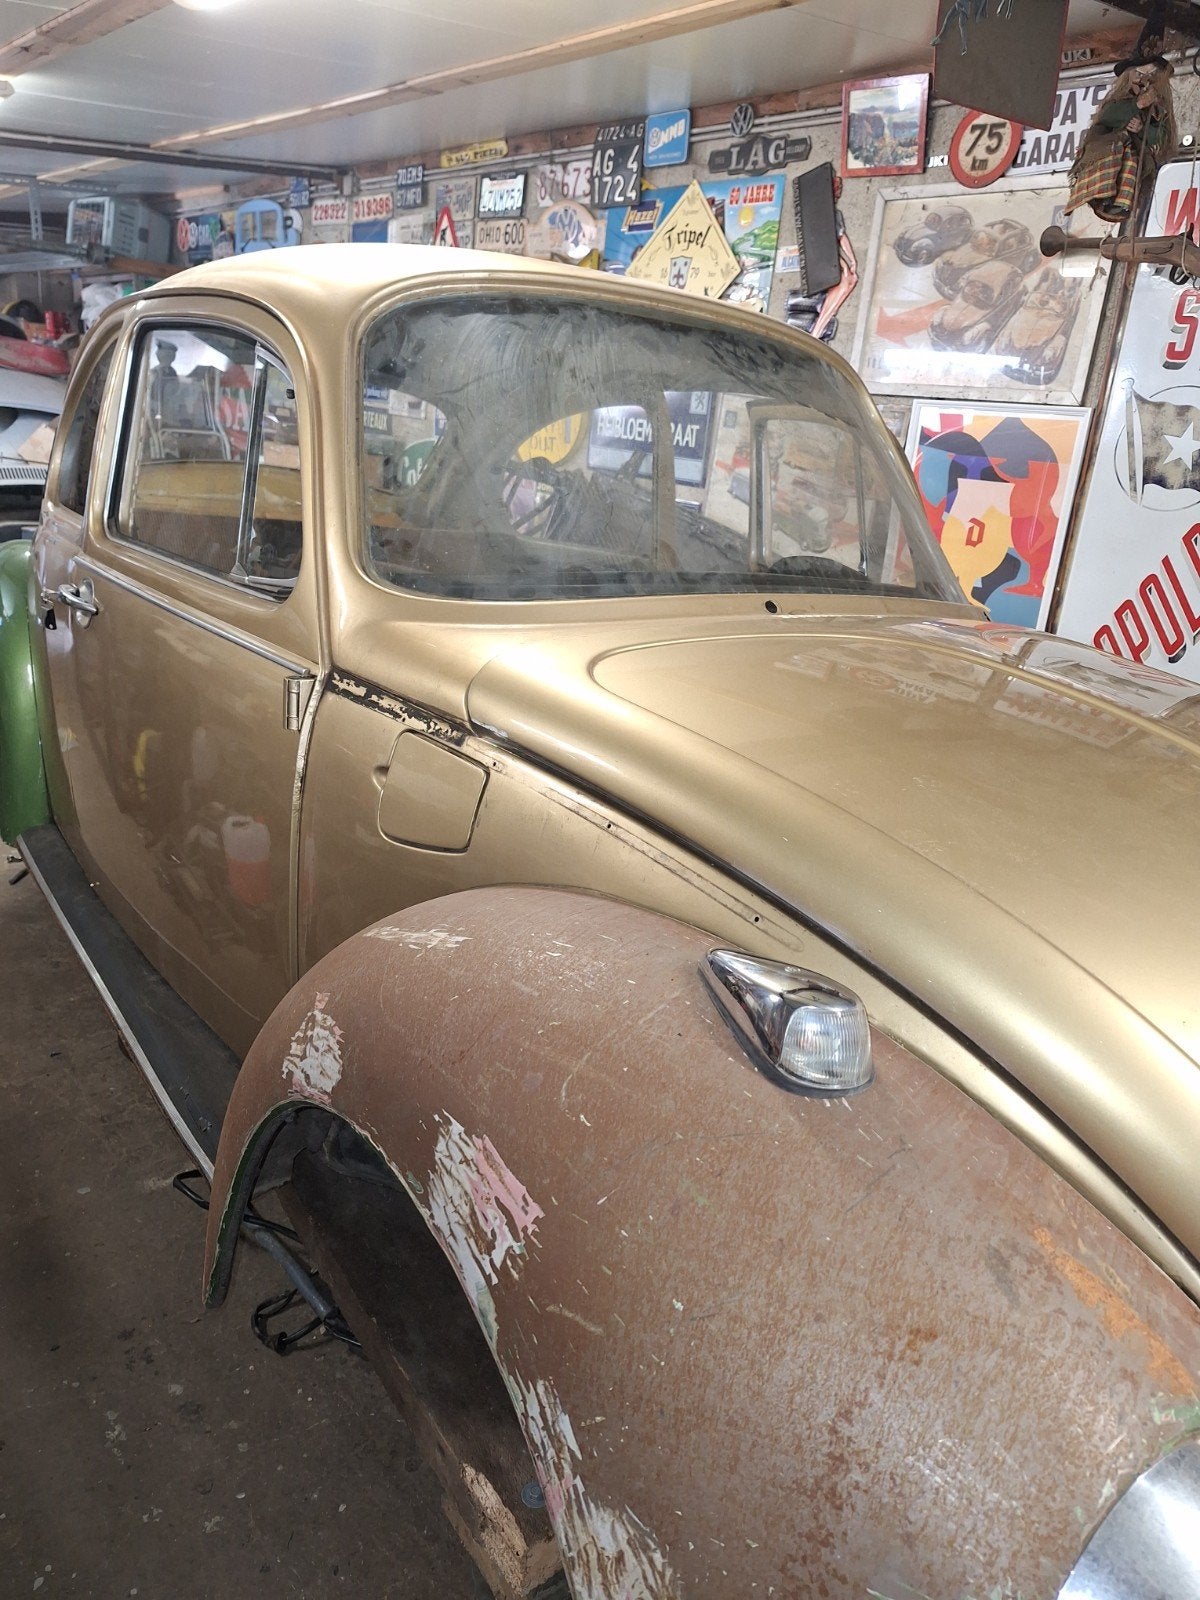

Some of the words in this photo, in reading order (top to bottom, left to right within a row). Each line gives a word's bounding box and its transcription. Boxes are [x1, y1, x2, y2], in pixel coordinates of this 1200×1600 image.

[965, 121, 1006, 156] 75
[593, 148, 615, 177] AG
[627, 145, 640, 174] 4
[971, 156, 988, 171] km
[593, 173, 638, 204] 1724
[743, 184, 776, 204] JAHRE
[479, 226, 502, 244] OHIO
[504, 222, 525, 245] 600
[663, 222, 713, 254] Tripel
